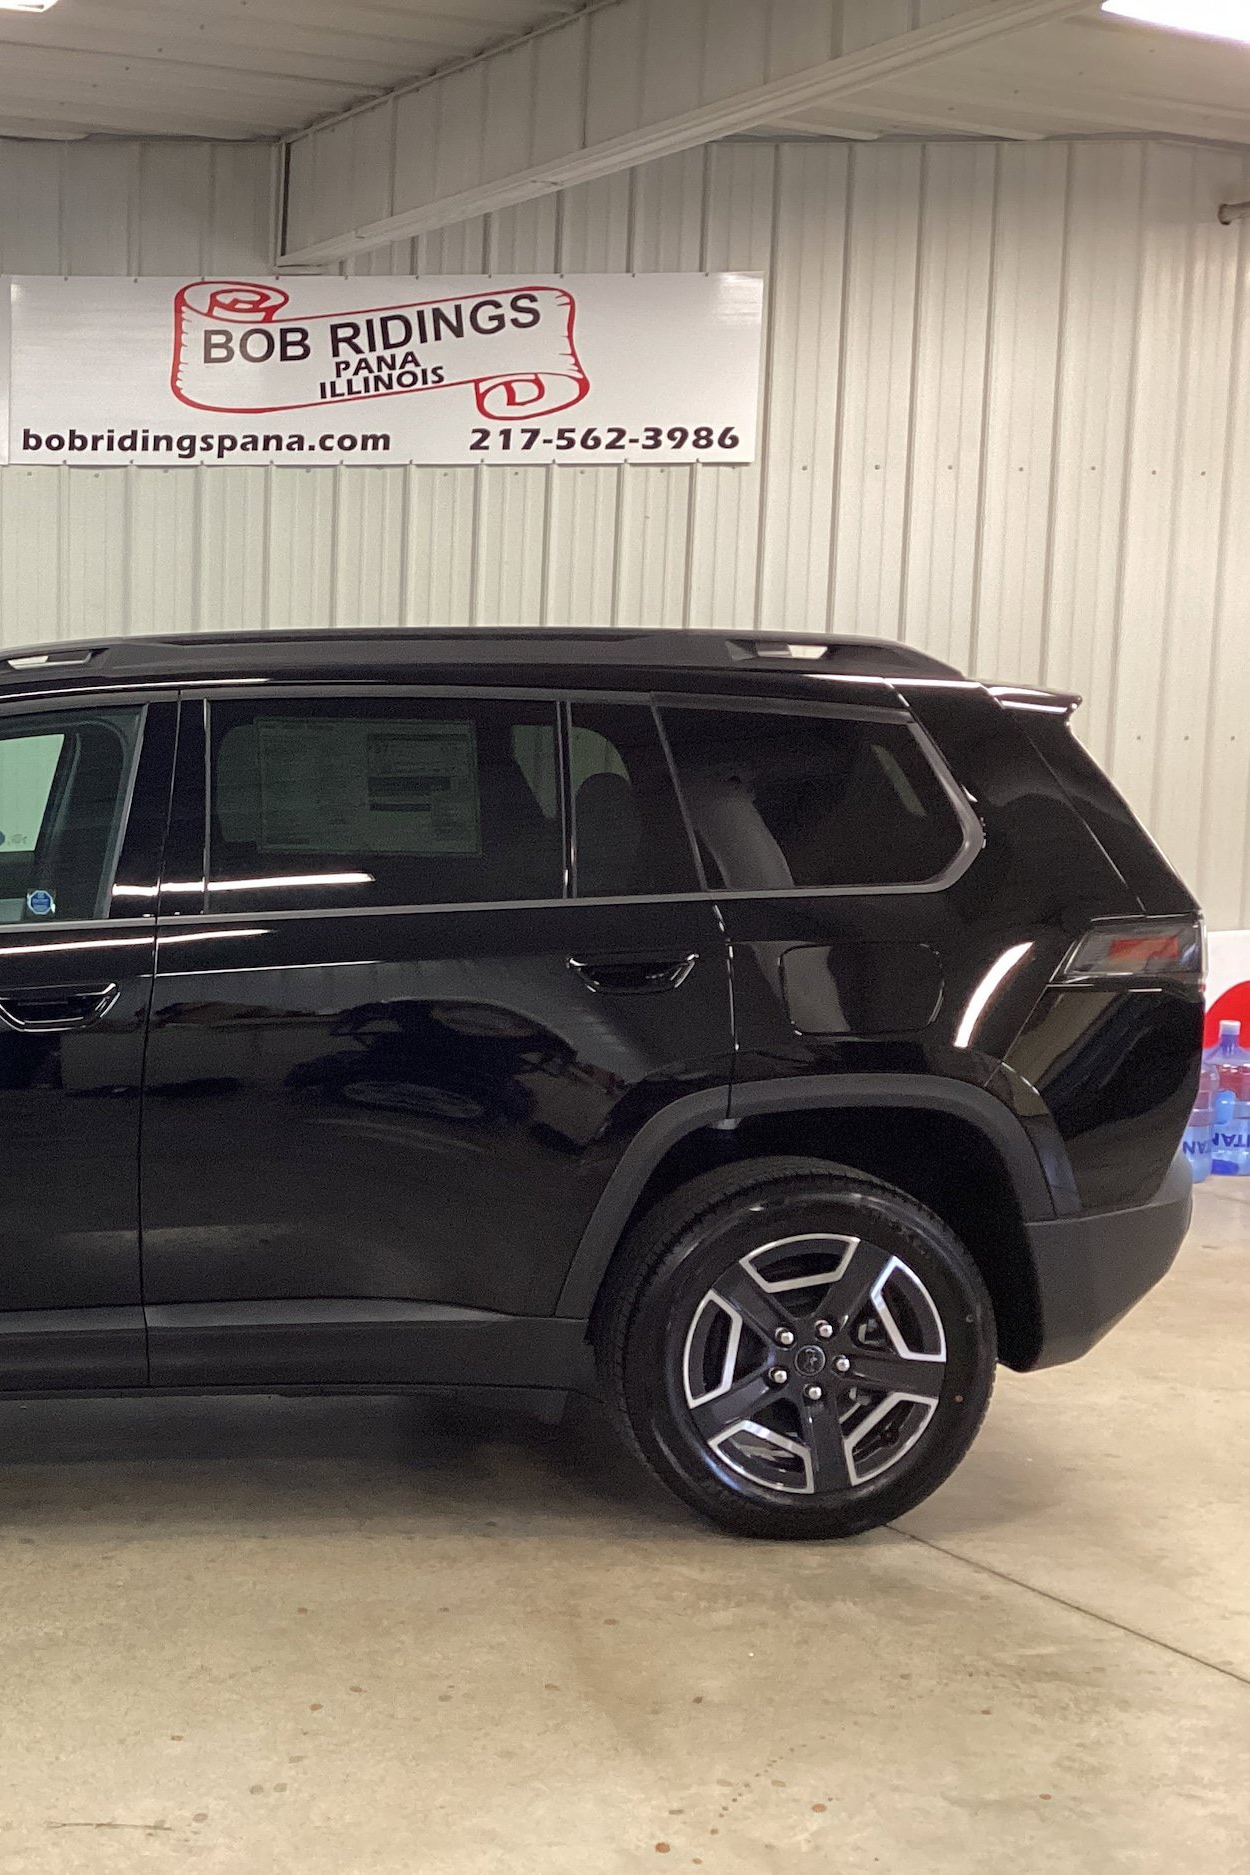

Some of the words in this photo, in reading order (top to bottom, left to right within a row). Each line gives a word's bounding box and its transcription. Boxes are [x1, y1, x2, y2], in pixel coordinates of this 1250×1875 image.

[203, 327, 311, 364] BOB
[330, 293, 541, 357] RIDINGS
[335, 351, 421, 378] PANA
[319, 366, 445, 399] ILLINOIS
[22, 428, 391, 459] bobridingspana.com
[469, 427, 740, 450] 217-562-3986
